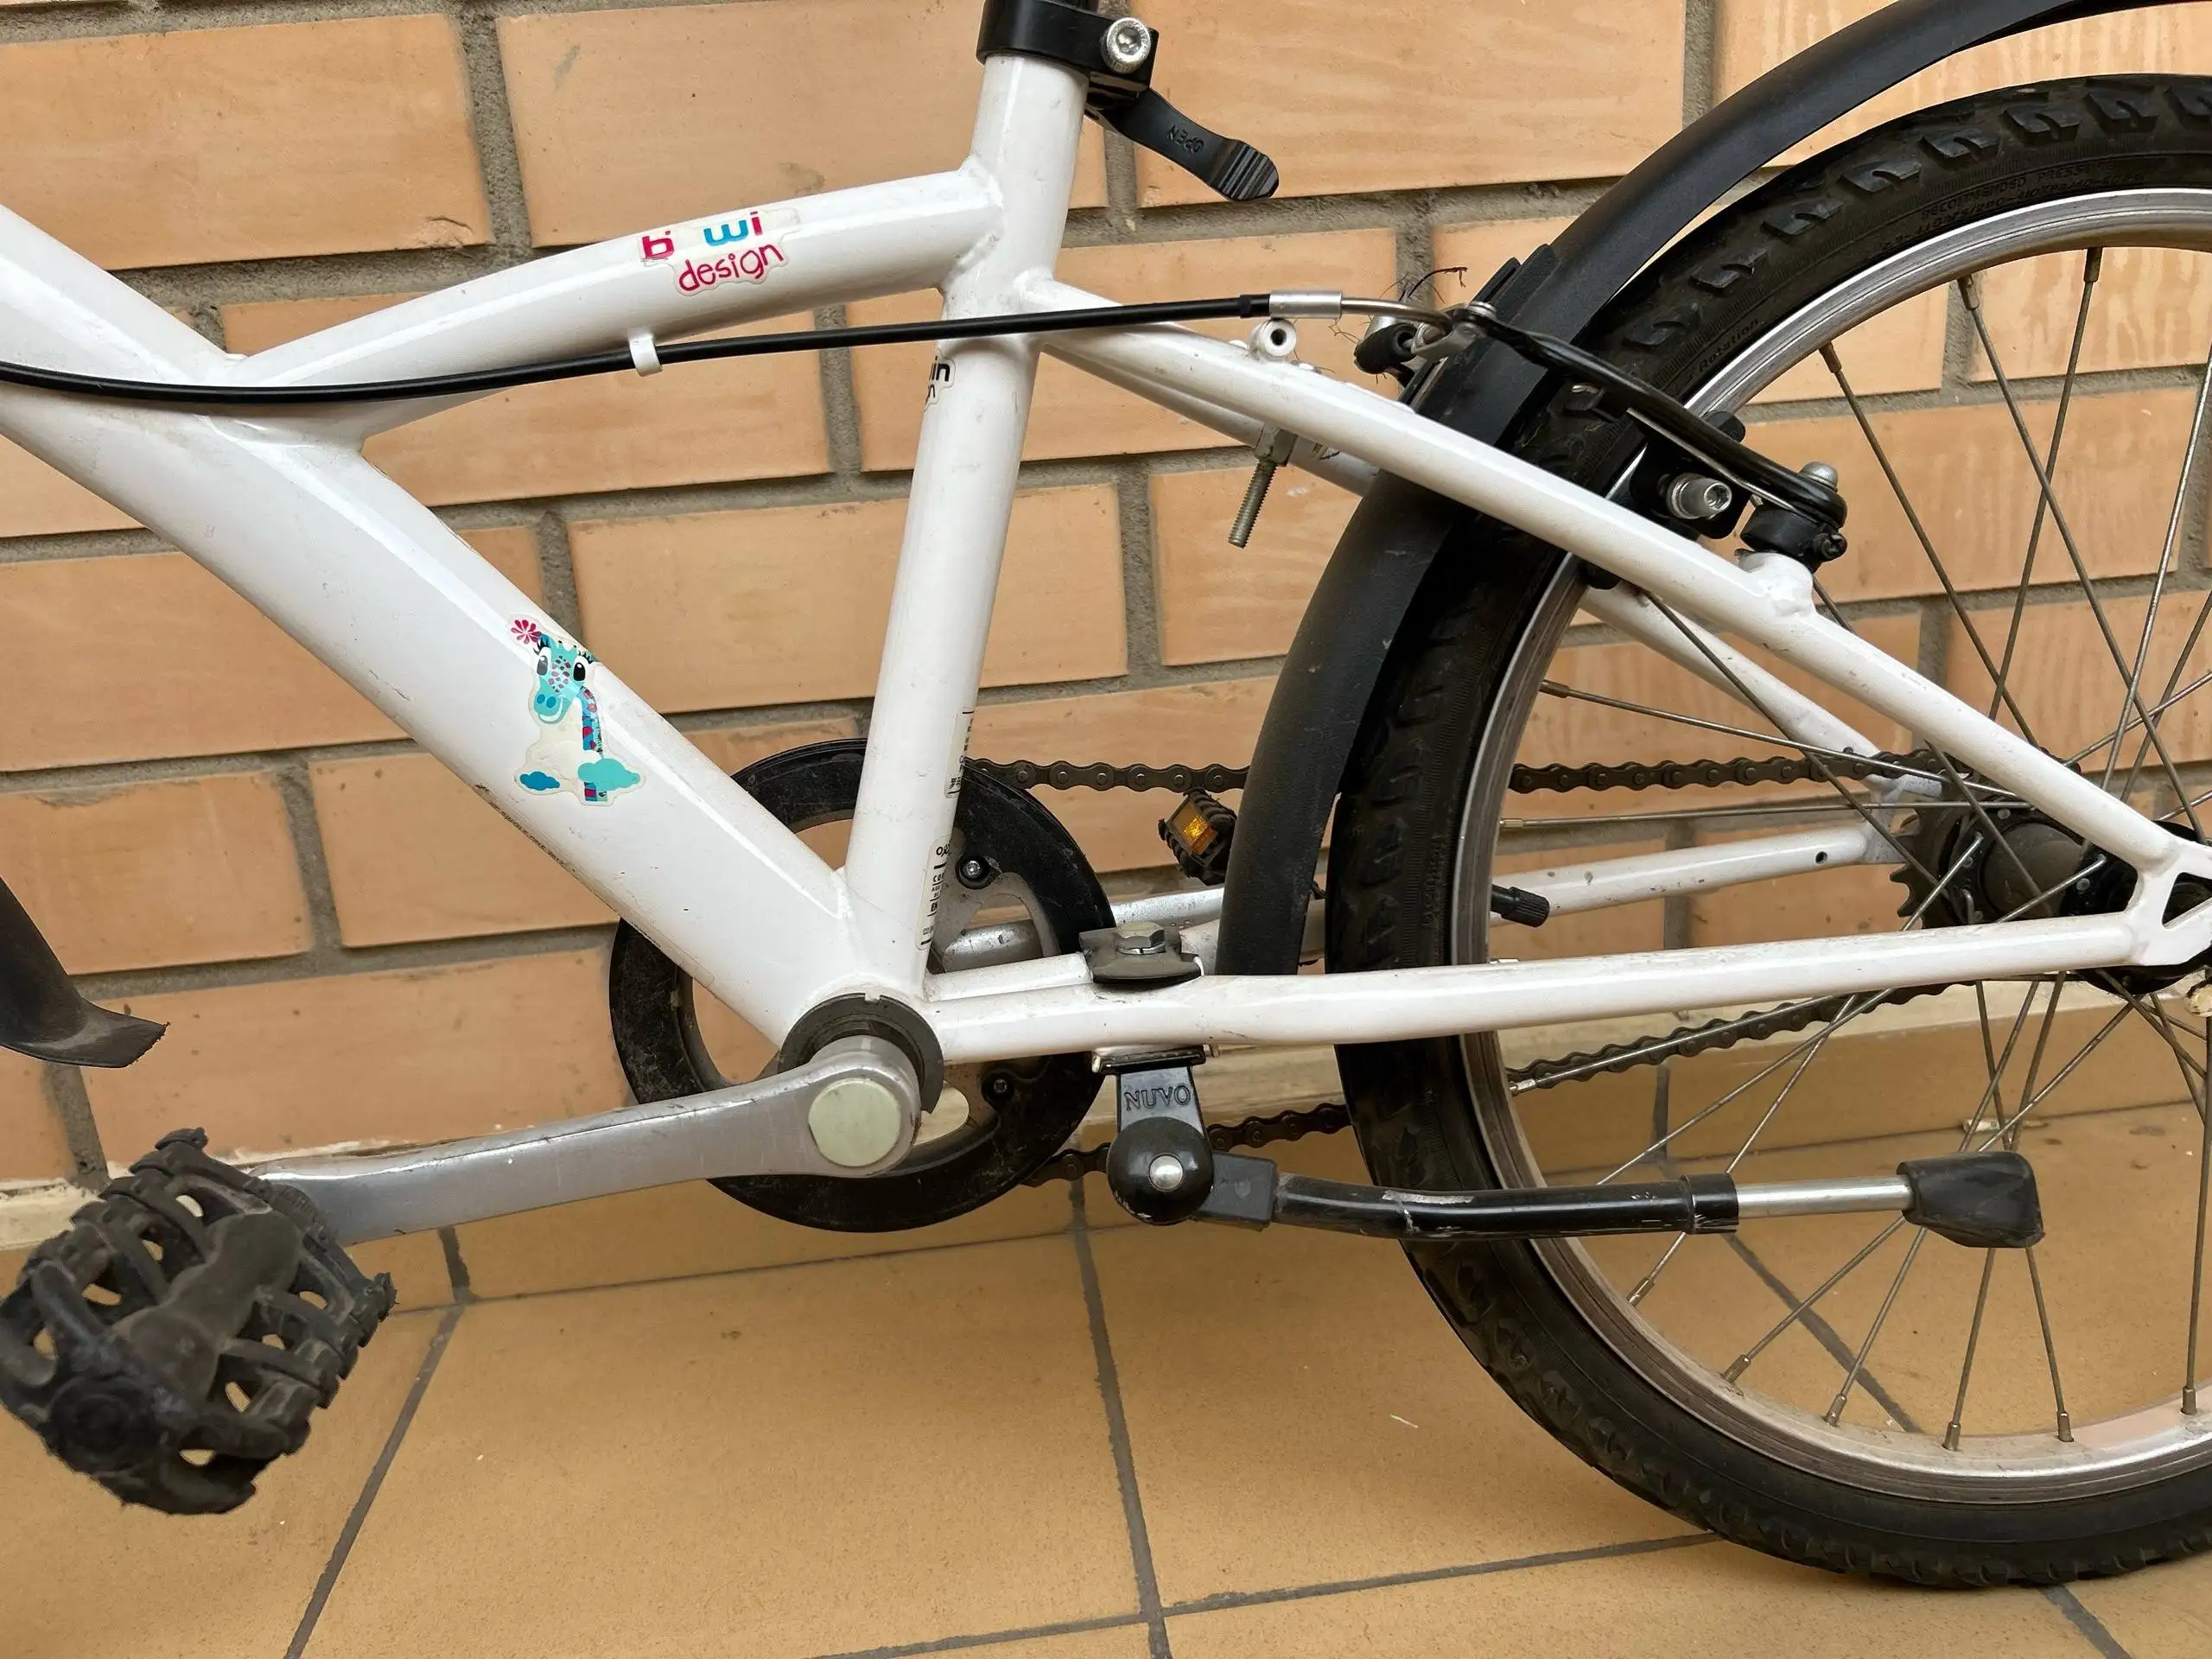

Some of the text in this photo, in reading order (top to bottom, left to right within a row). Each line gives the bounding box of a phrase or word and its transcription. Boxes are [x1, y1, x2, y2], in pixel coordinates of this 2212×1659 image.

[678, 244, 785, 291] design
[1698, 318, 1759, 373] Rotation
[1124, 1084, 1191, 1111] NUVO
